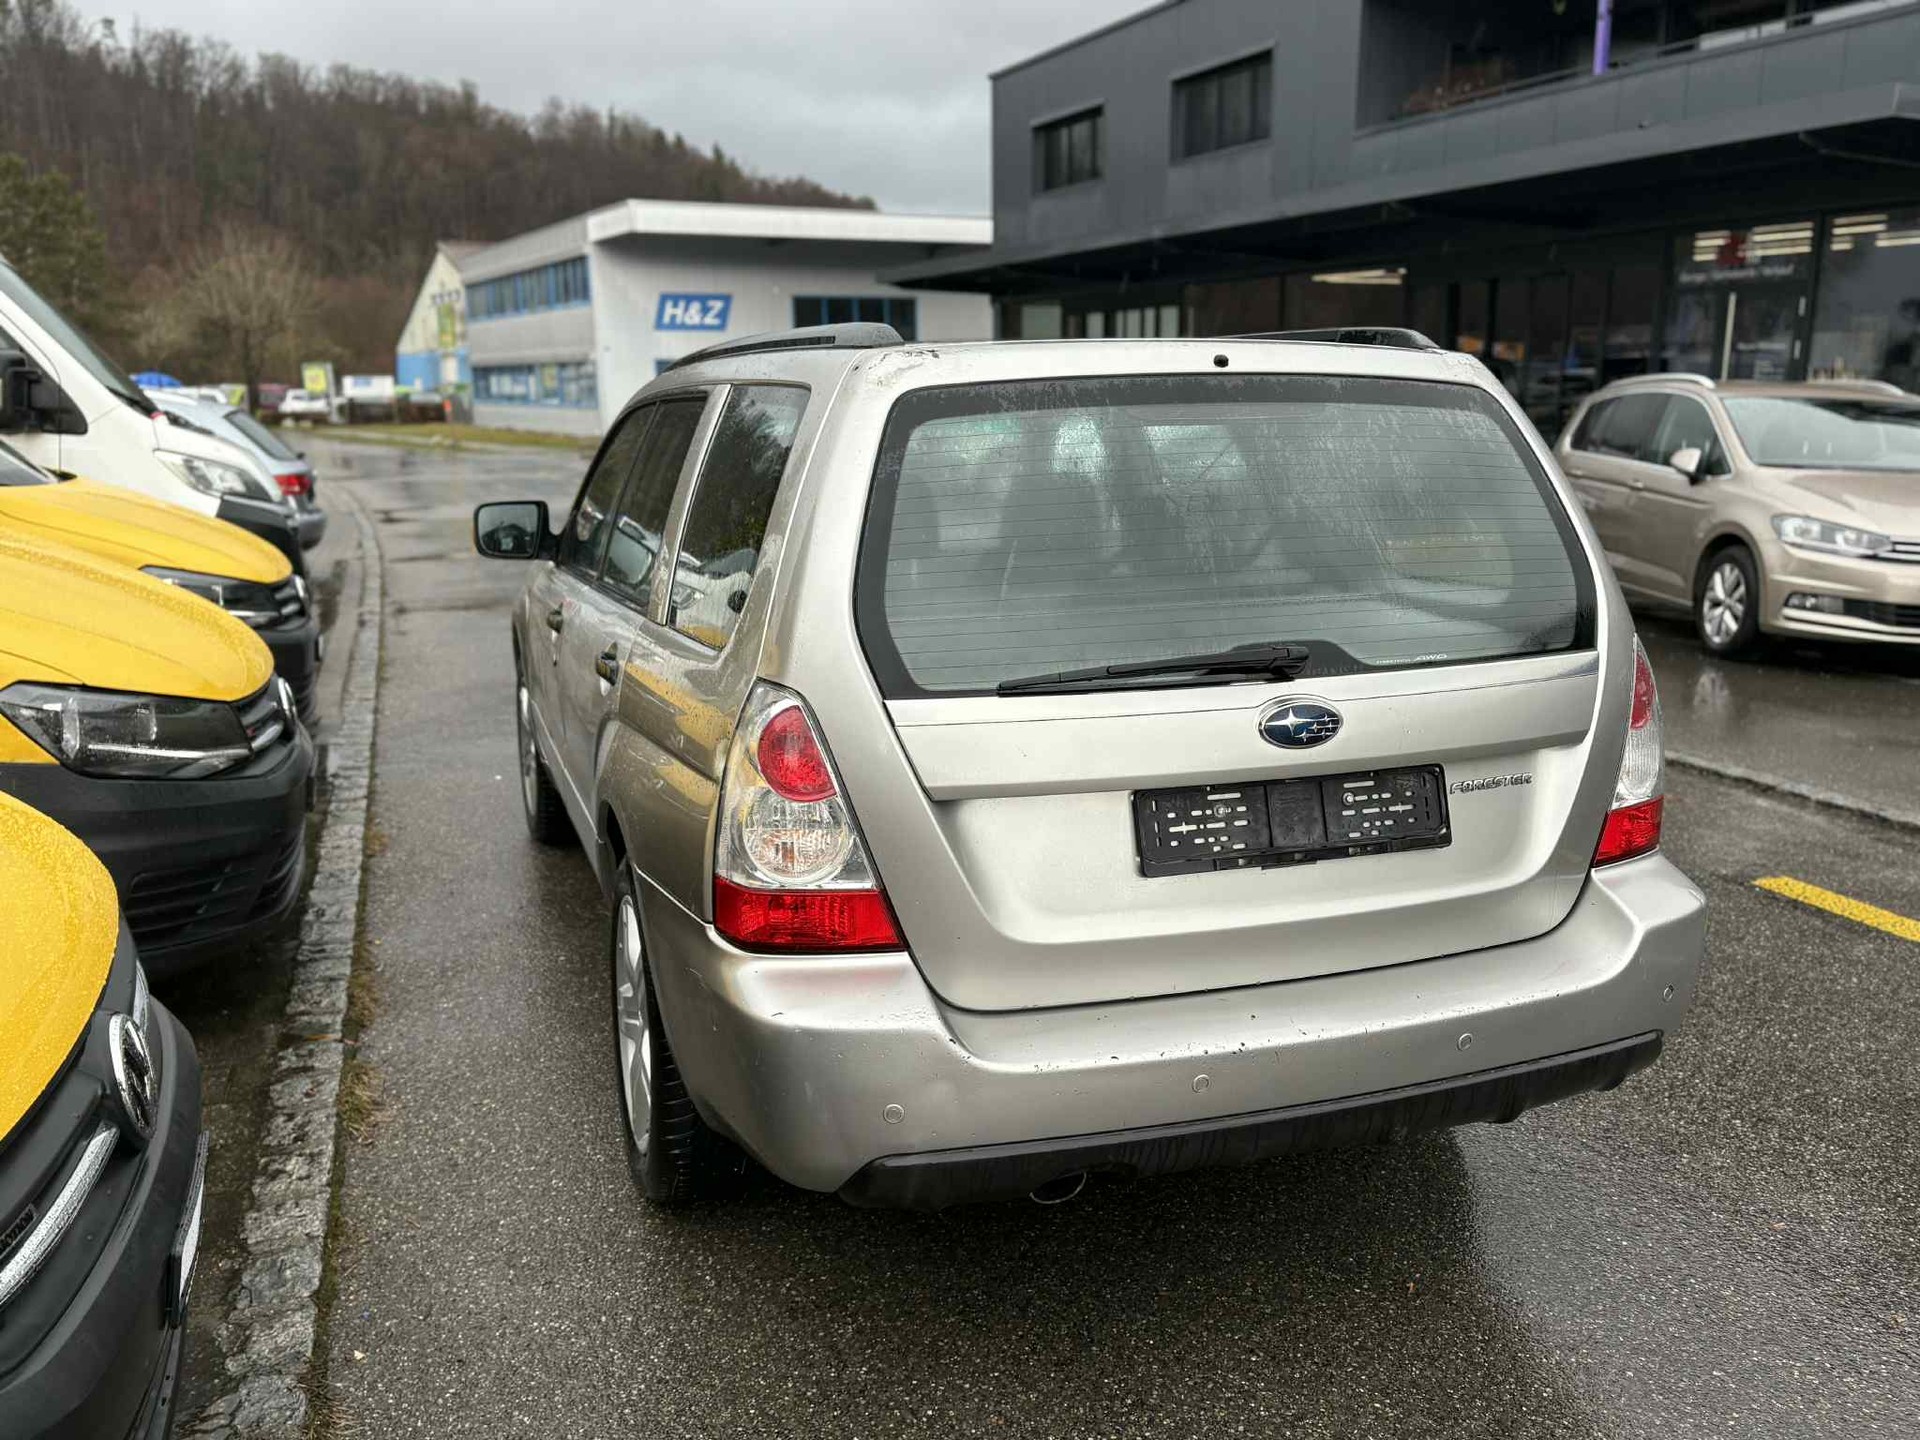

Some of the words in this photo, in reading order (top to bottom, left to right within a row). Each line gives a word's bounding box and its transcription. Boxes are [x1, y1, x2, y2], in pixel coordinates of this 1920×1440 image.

[662, 299, 725, 326] H&Z
[1414, 653, 1448, 662] AWD
[1449, 772, 1533, 795] FORESTER
